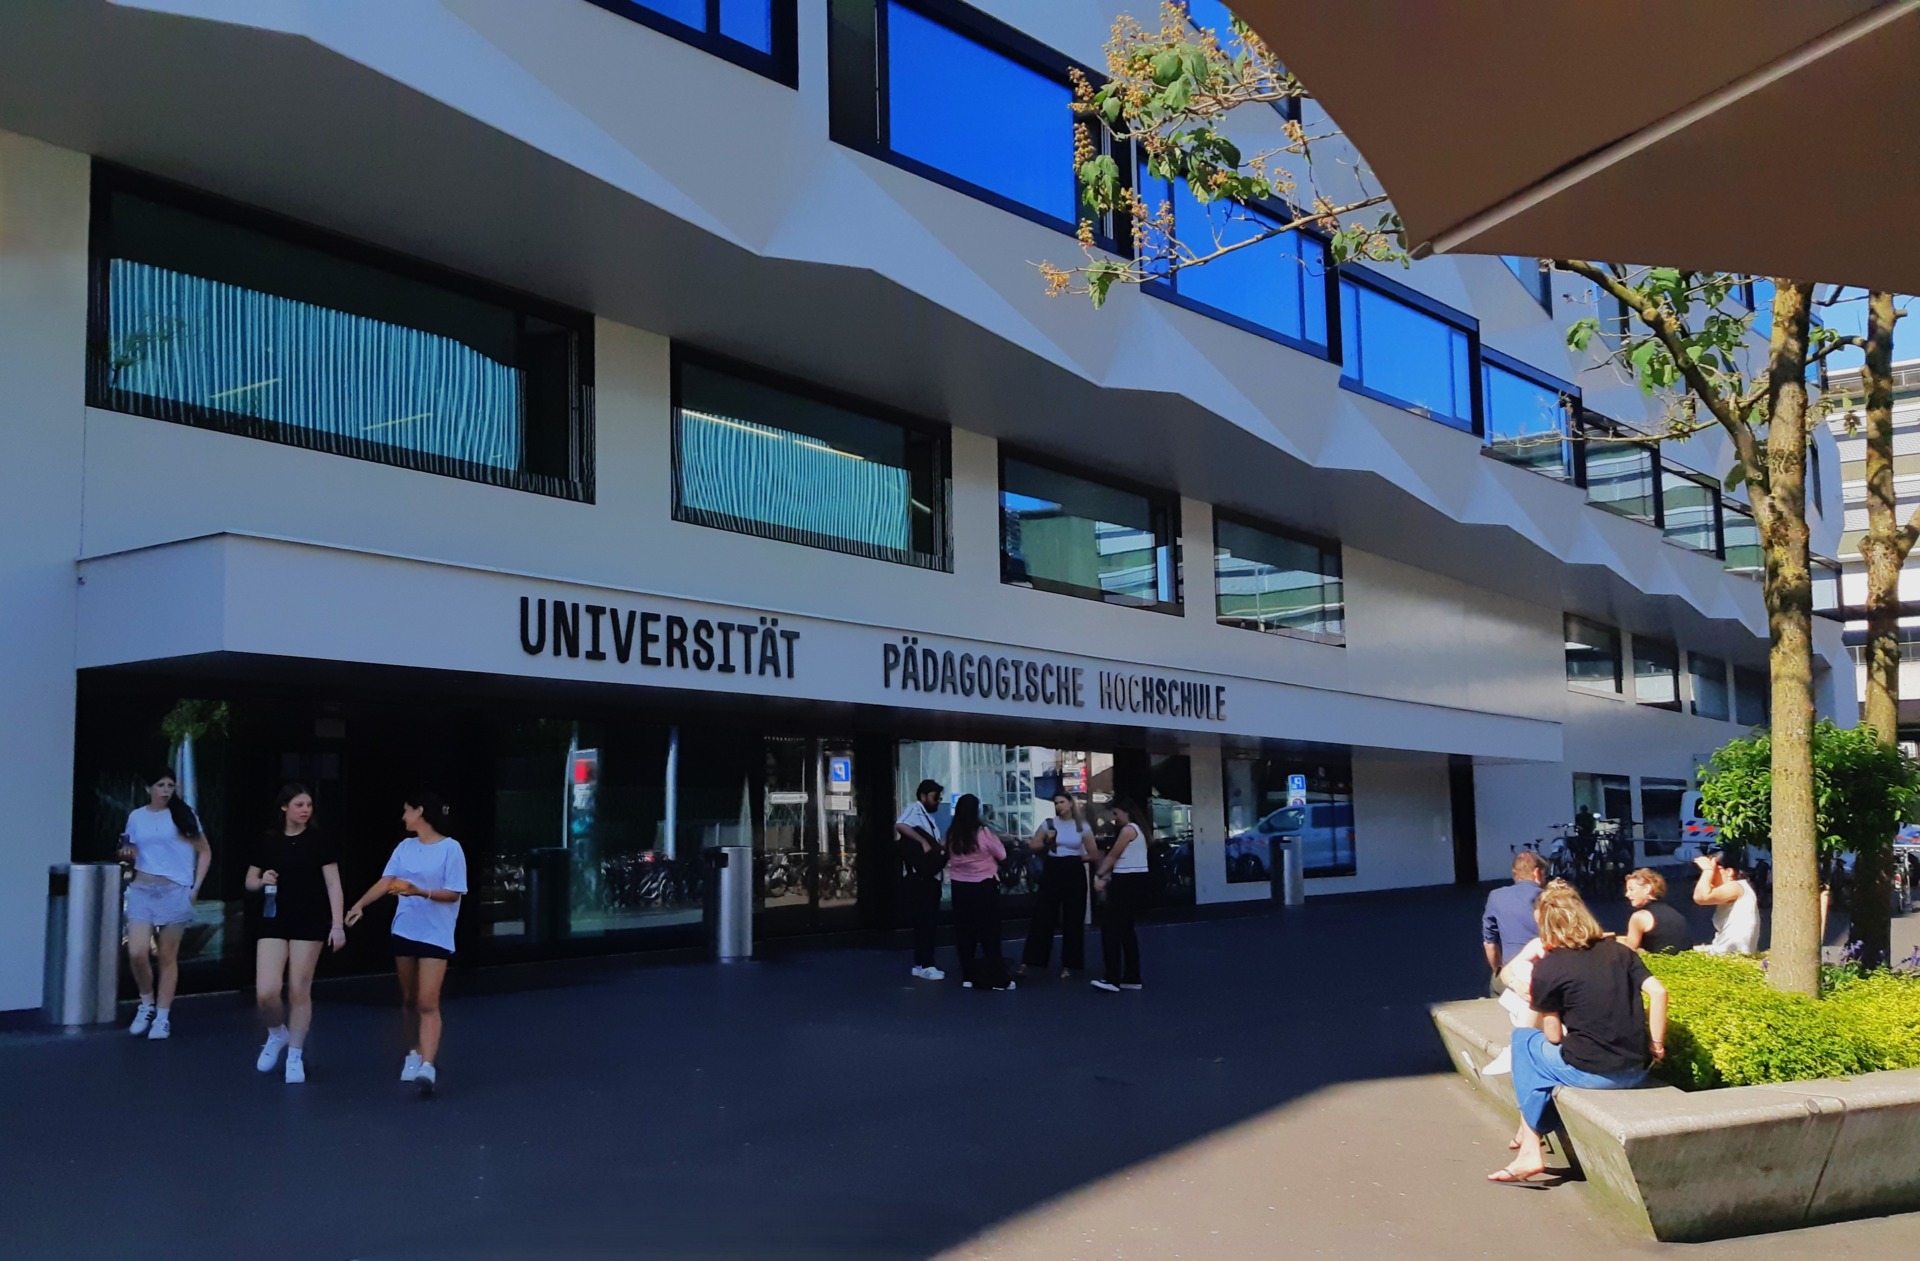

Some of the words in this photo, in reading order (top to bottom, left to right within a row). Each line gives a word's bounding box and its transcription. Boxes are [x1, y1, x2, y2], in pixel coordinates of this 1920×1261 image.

[520, 596, 800, 678] UNIVERSITÄT
[883, 636, 1085, 708] PÄDAGOGISCHE
[1099, 670, 1227, 721] HOCHSCHULE
